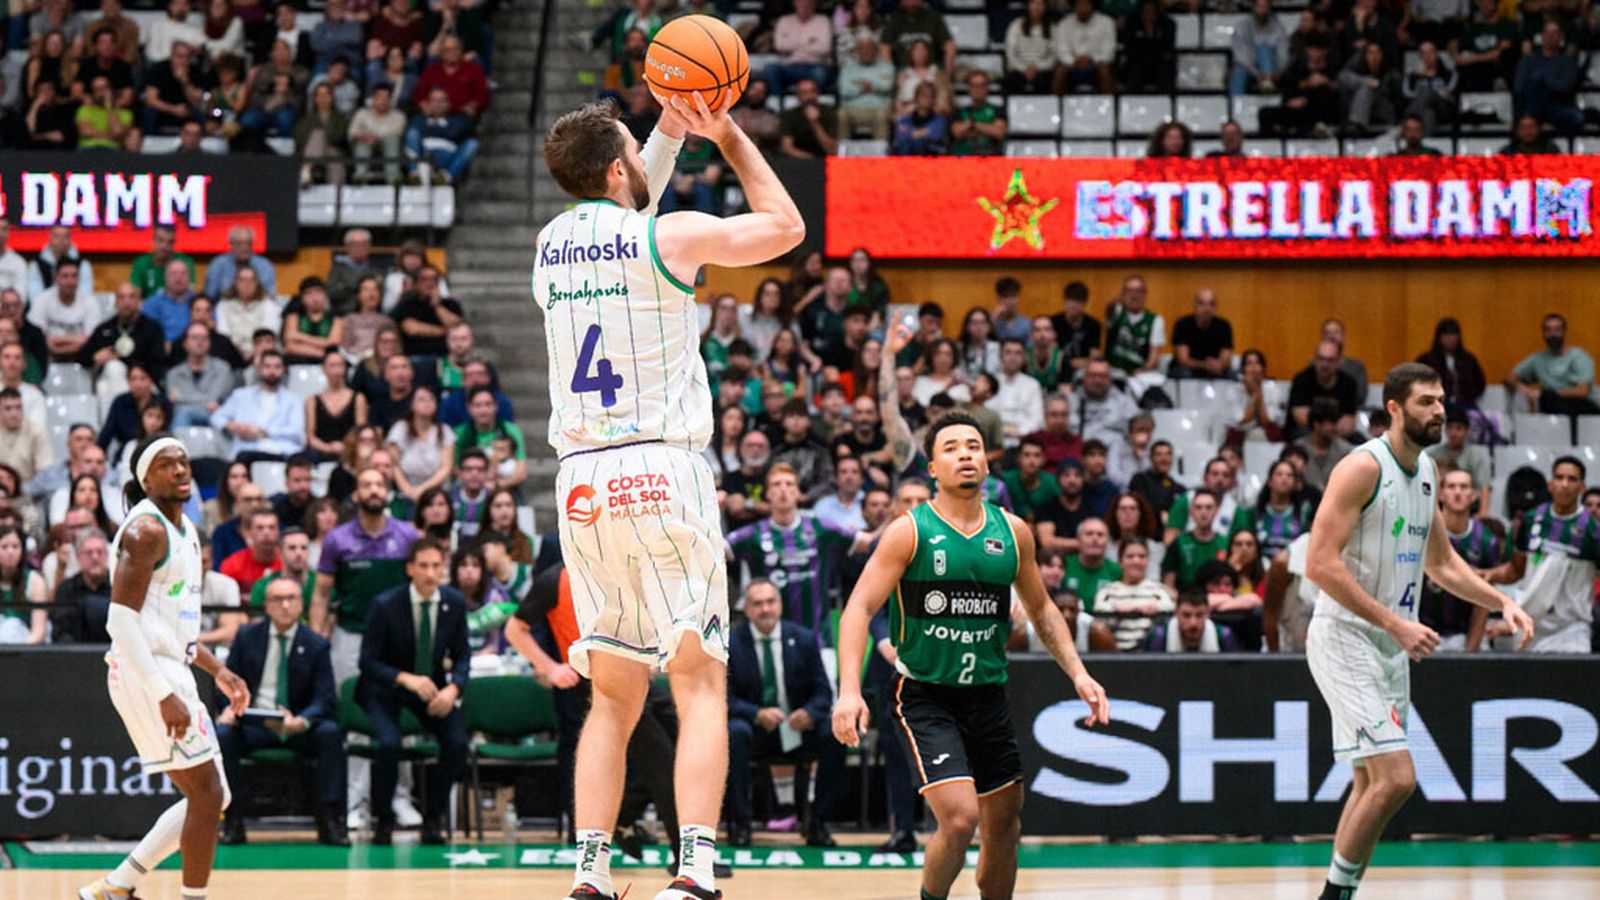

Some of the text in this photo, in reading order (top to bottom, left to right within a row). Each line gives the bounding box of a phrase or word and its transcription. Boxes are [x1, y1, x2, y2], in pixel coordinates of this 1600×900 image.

[21, 172, 210, 228] DAMM
[1075, 178, 1591, 239] ESTRELLA DAMM
[540, 234, 638, 268] Kalinoski
[571, 324, 624, 408] 4
[607, 474, 670, 492] COSTA
[608, 490, 671, 508] DEL SOL
[958, 653, 976, 684] 2
